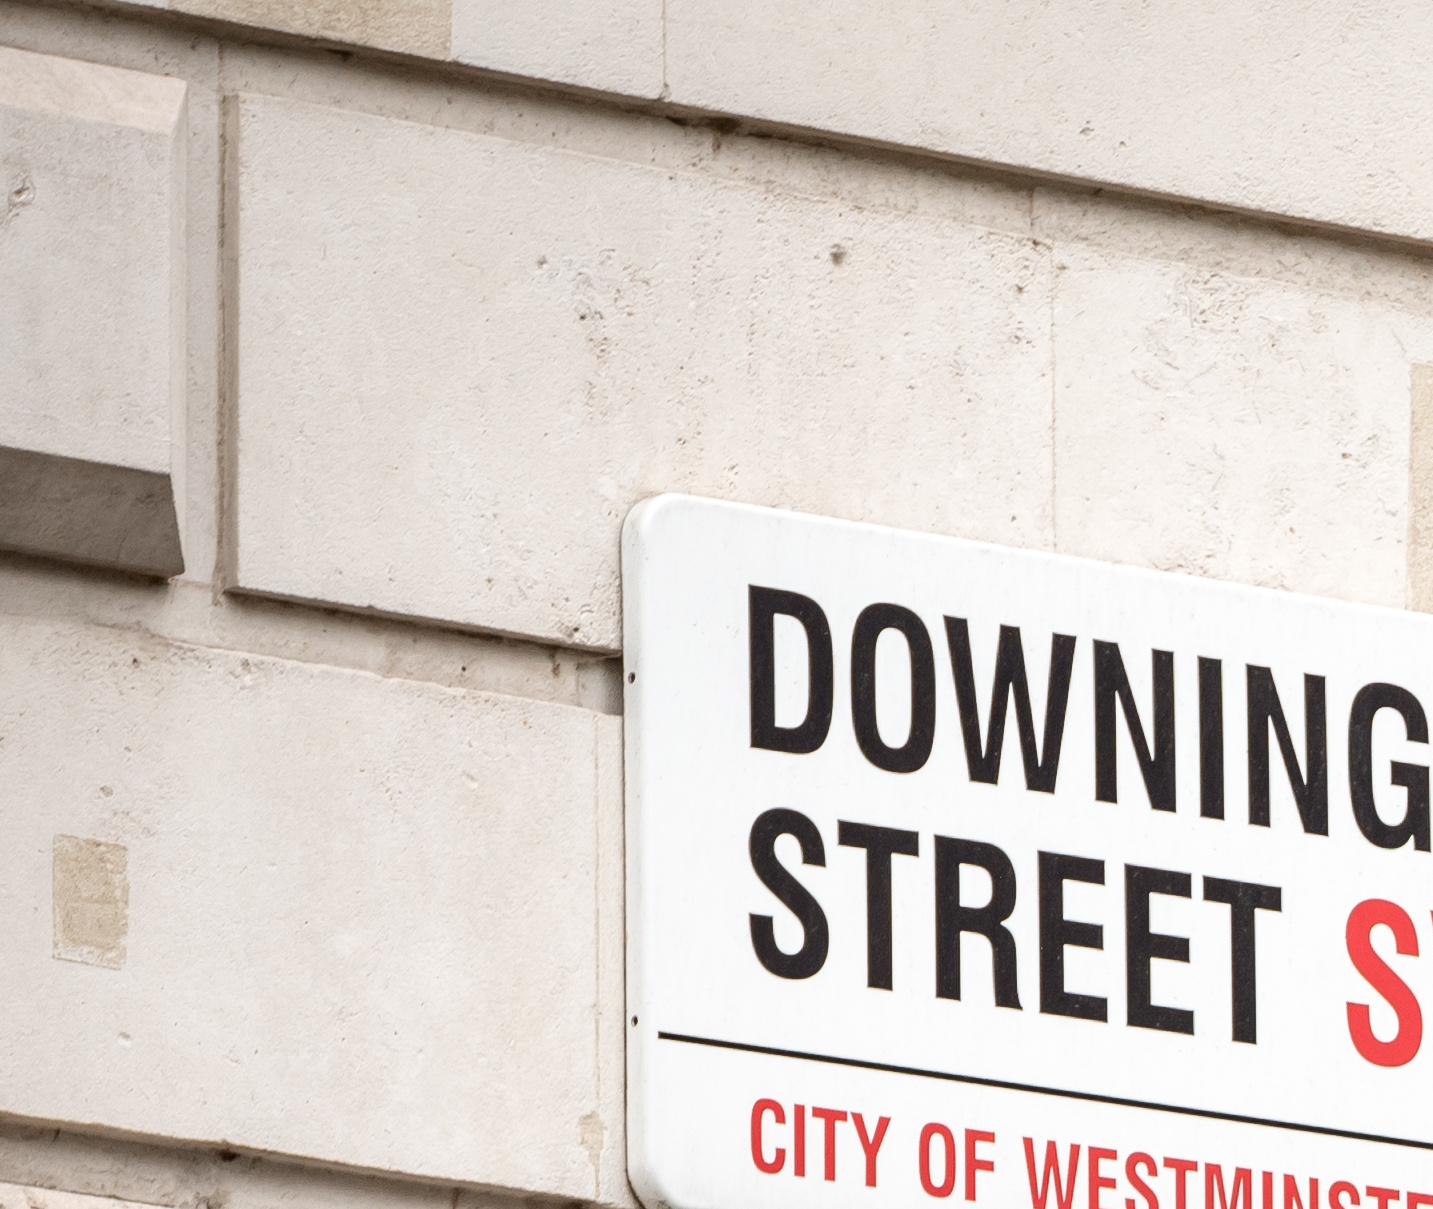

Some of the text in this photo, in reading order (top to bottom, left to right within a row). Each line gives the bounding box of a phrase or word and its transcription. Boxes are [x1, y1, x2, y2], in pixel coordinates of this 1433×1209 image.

[747, 583, 1433, 854] DOWNING
[747, 806, 1282, 1046] STREET
[749, 1097, 892, 1189] CITY
[917, 1121, 997, 1203] OF
